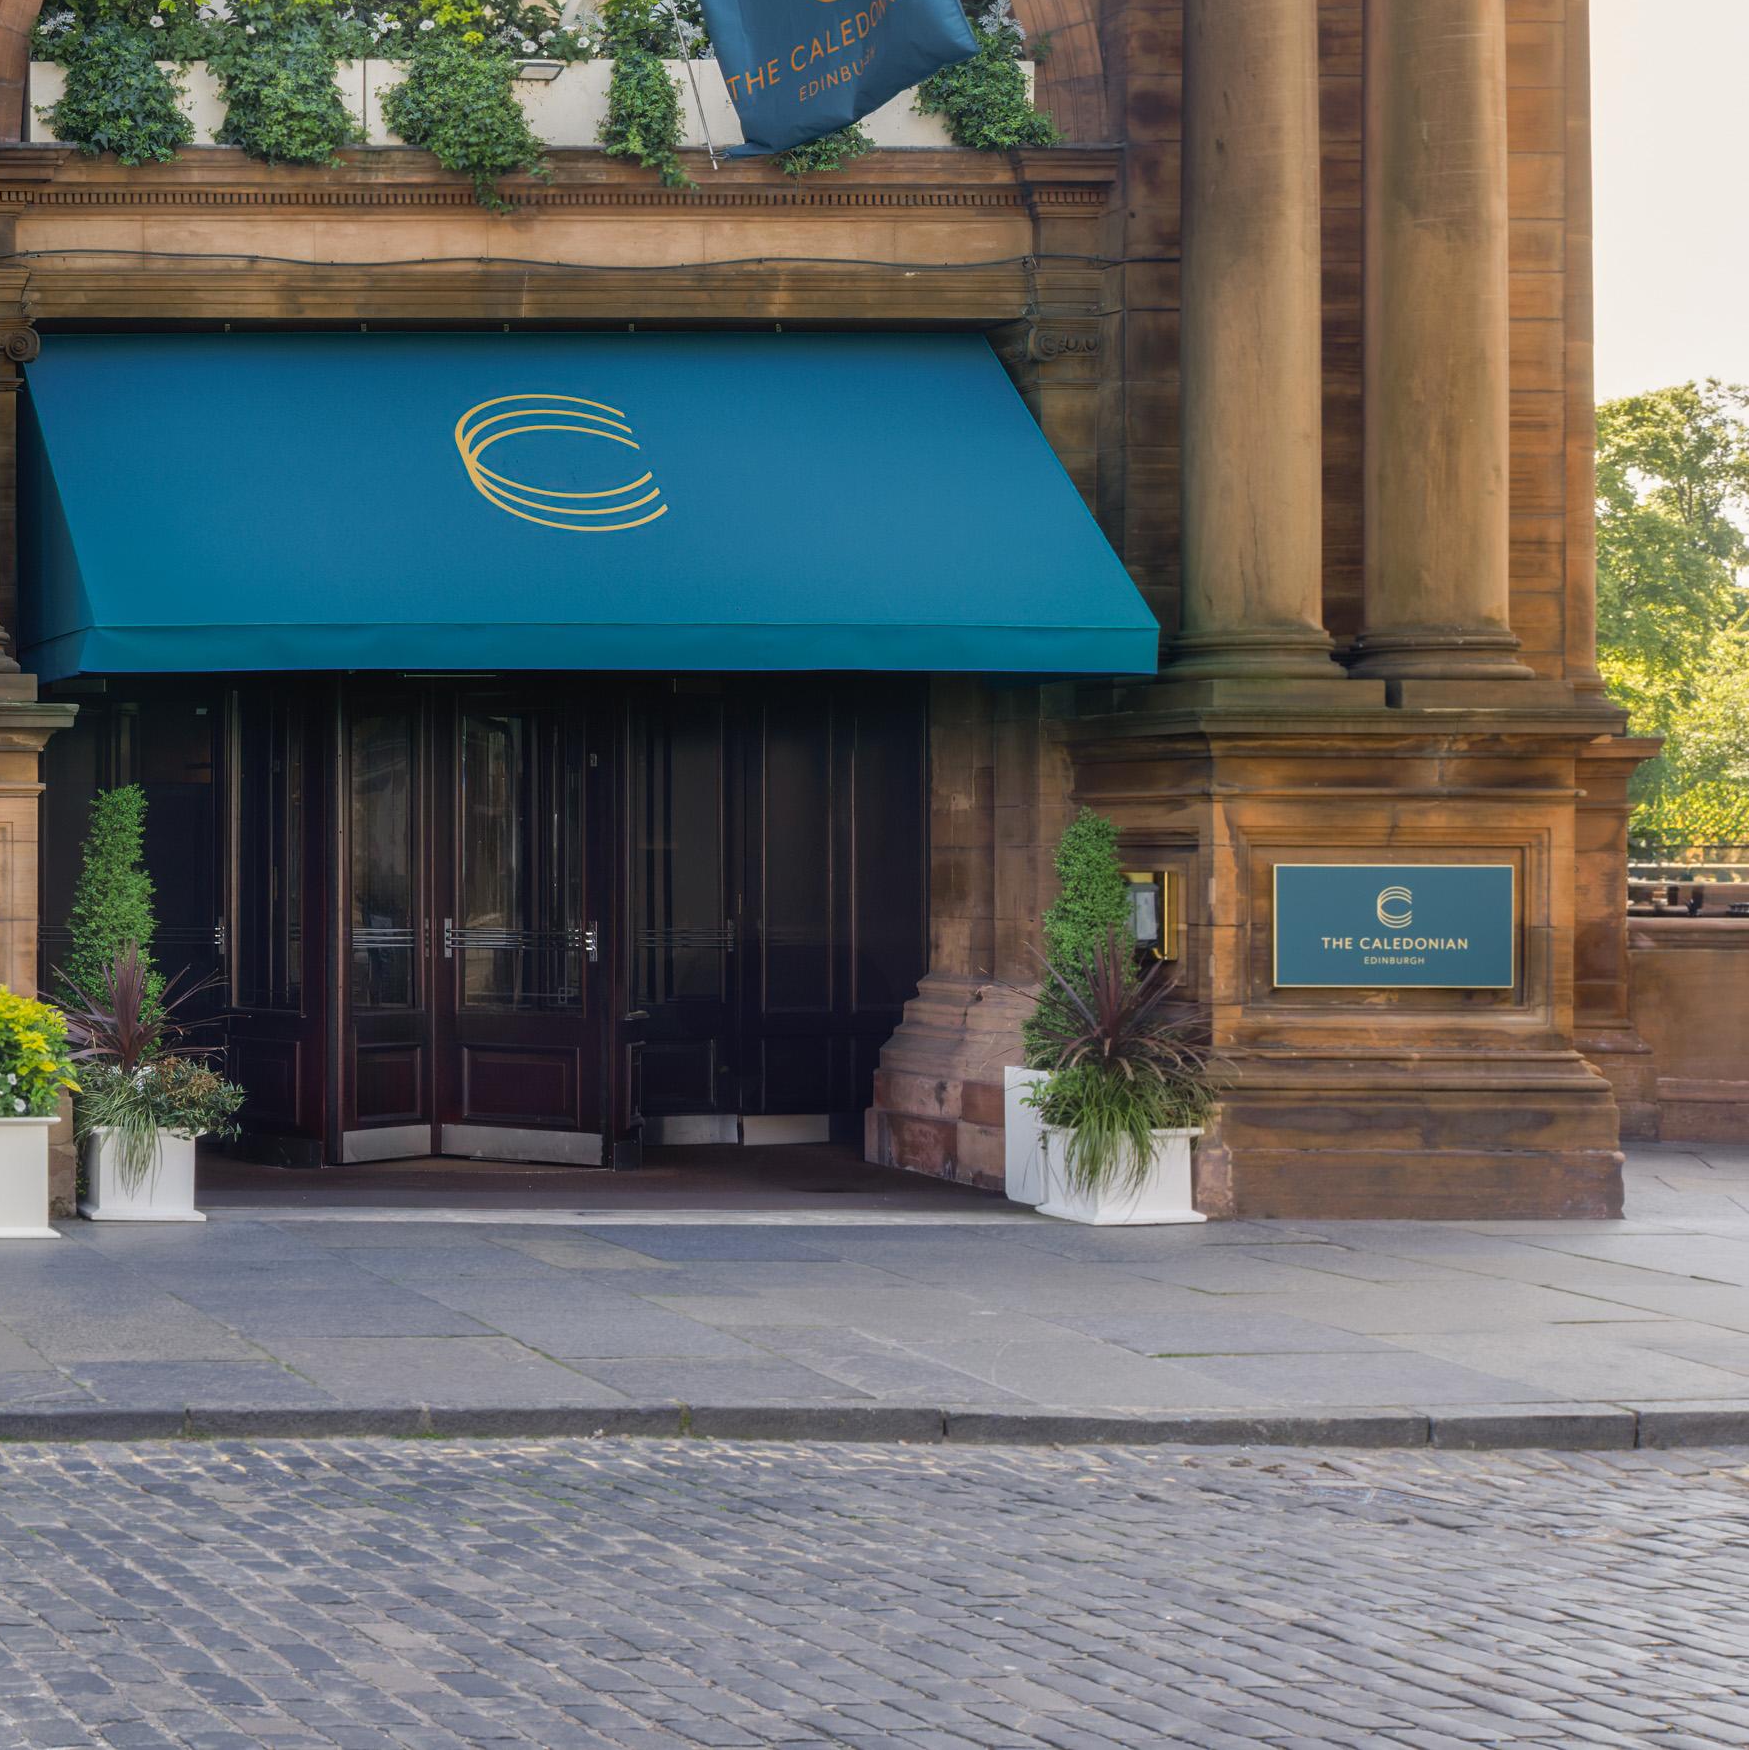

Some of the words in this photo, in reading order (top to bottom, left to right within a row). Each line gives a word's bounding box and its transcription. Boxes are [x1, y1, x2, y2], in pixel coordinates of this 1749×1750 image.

[726, 58, 781, 101] THE
[798, 45, 876, 102] EDINBU
[1320, 937, 1354, 950] THE
[1359, 937, 1469, 951] CALEDONIAN
[1363, 956, 1426, 965] EDINBURGH
